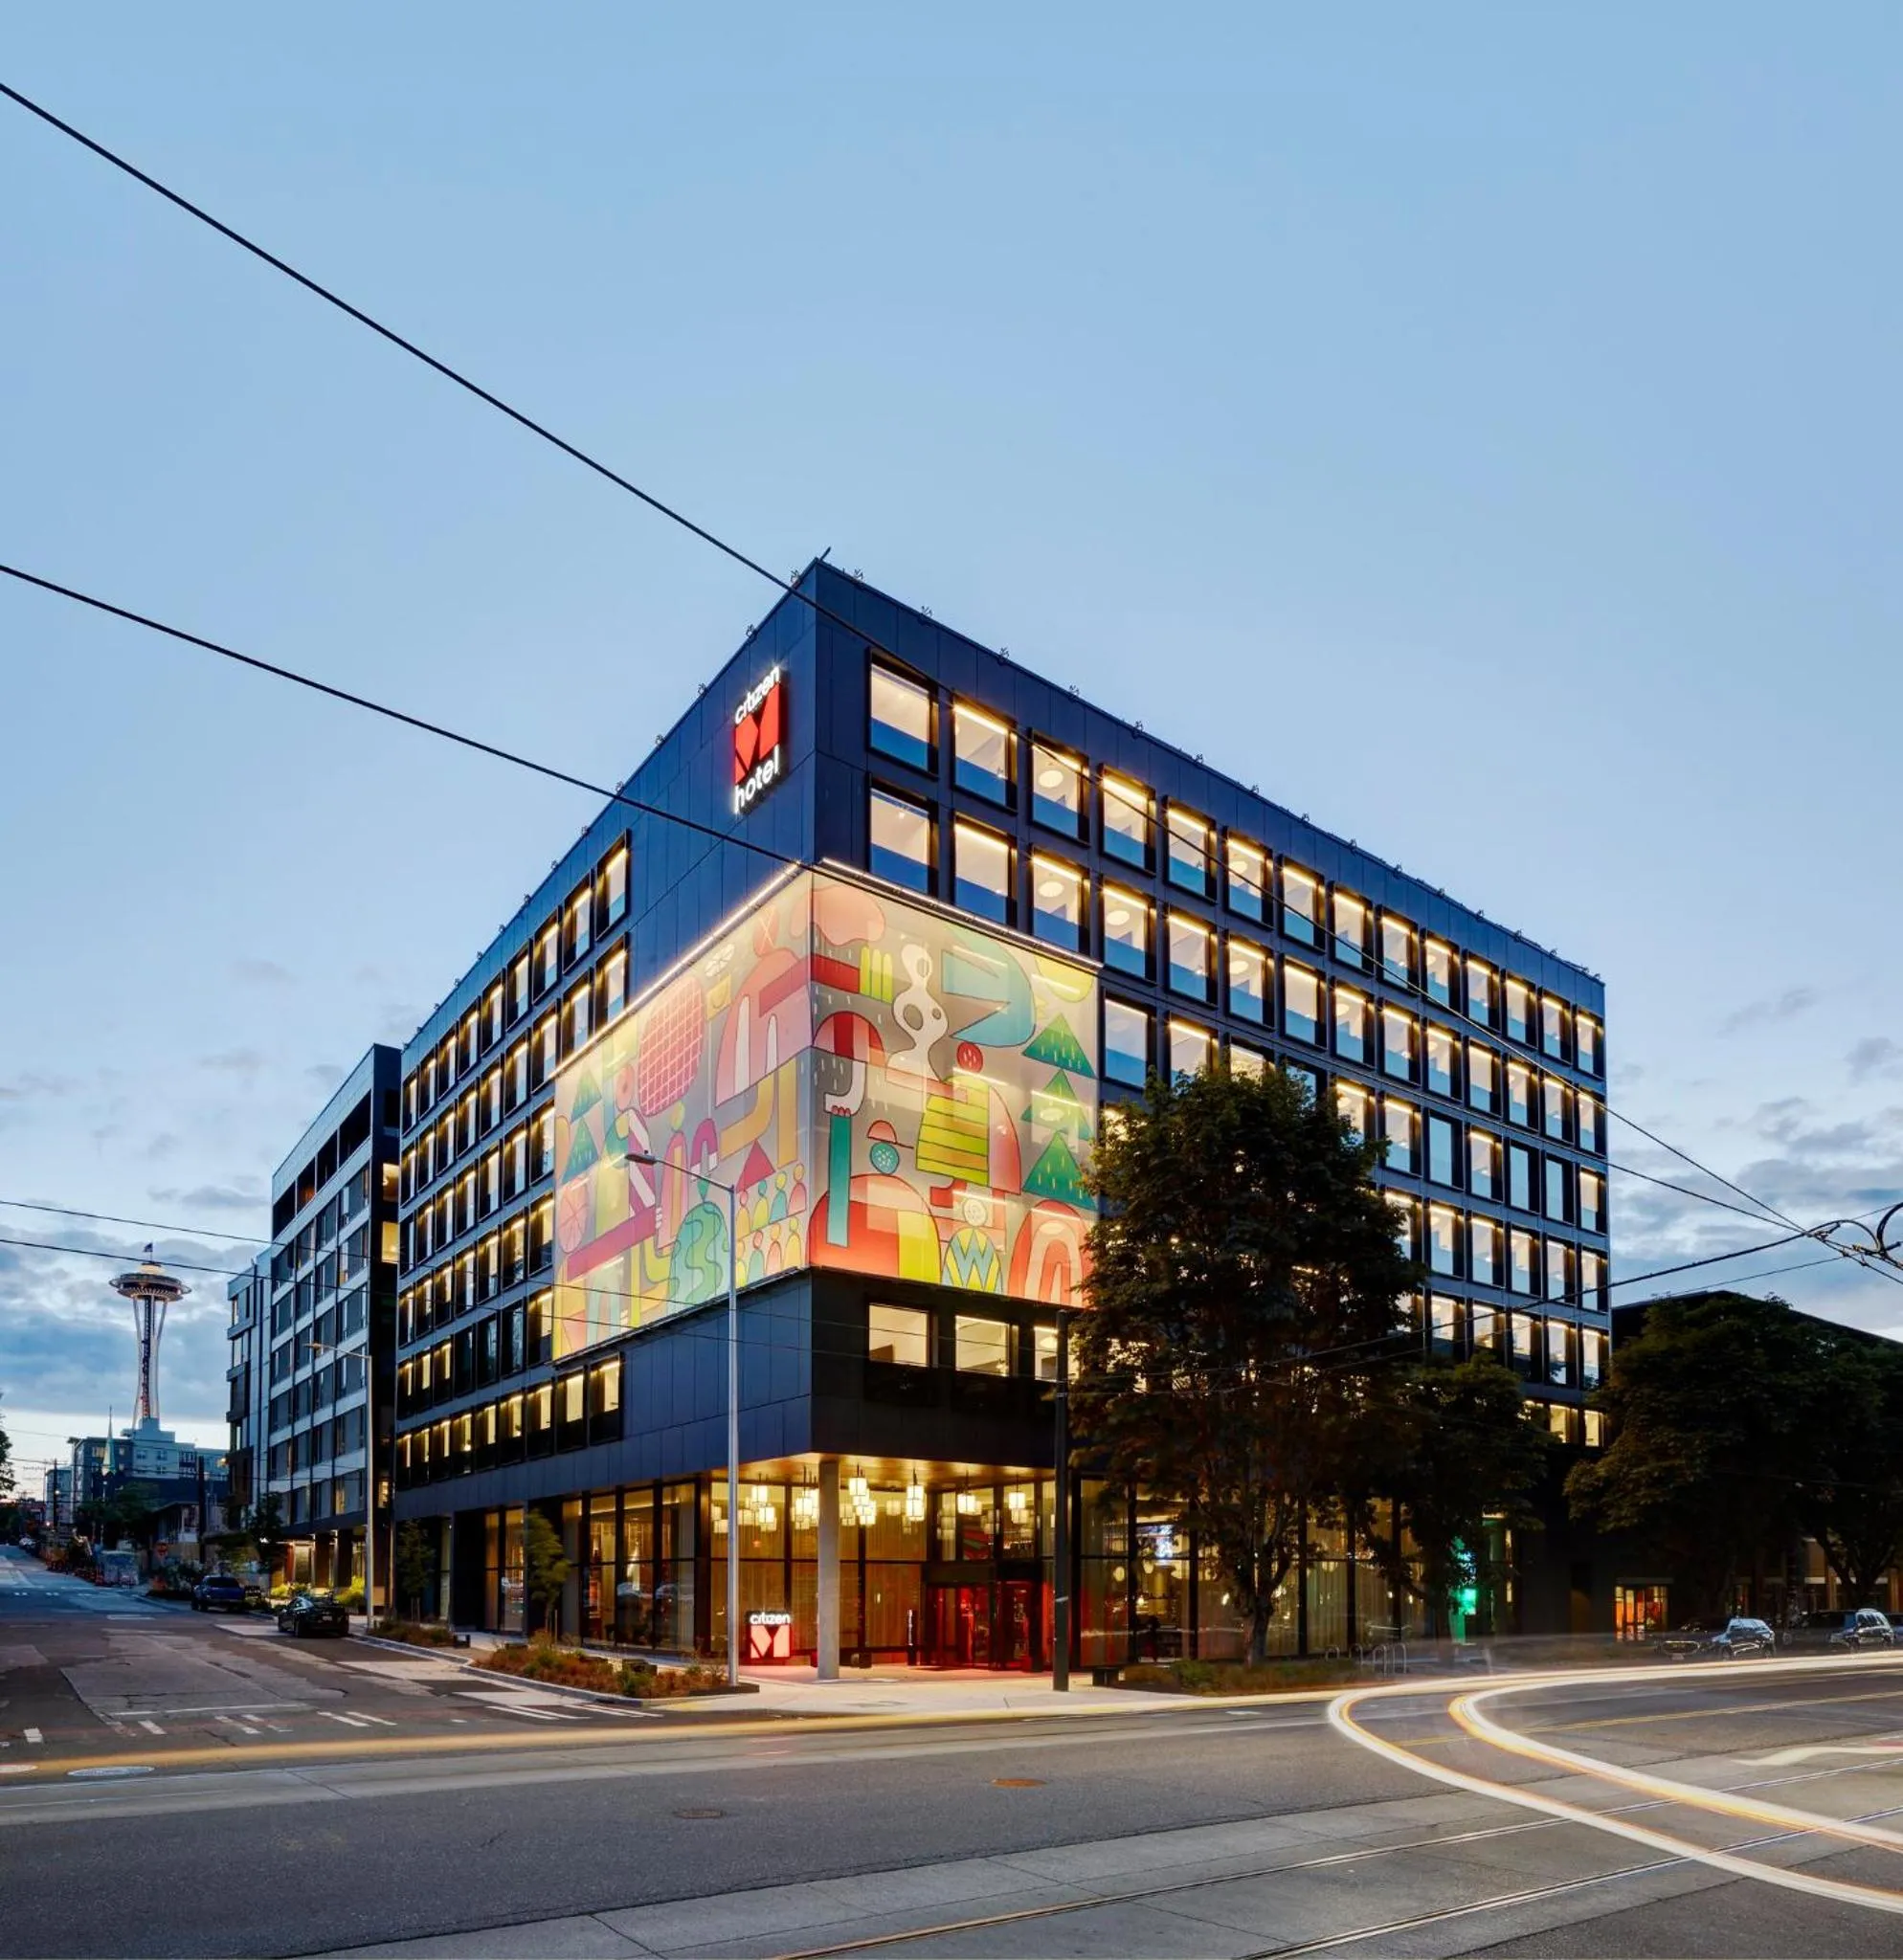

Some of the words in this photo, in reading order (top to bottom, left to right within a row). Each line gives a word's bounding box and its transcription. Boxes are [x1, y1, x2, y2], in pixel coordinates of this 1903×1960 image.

[735, 666, 780, 724] citizen
[735, 744, 780, 813] hotel
[750, 1612, 791, 1625] citizen
